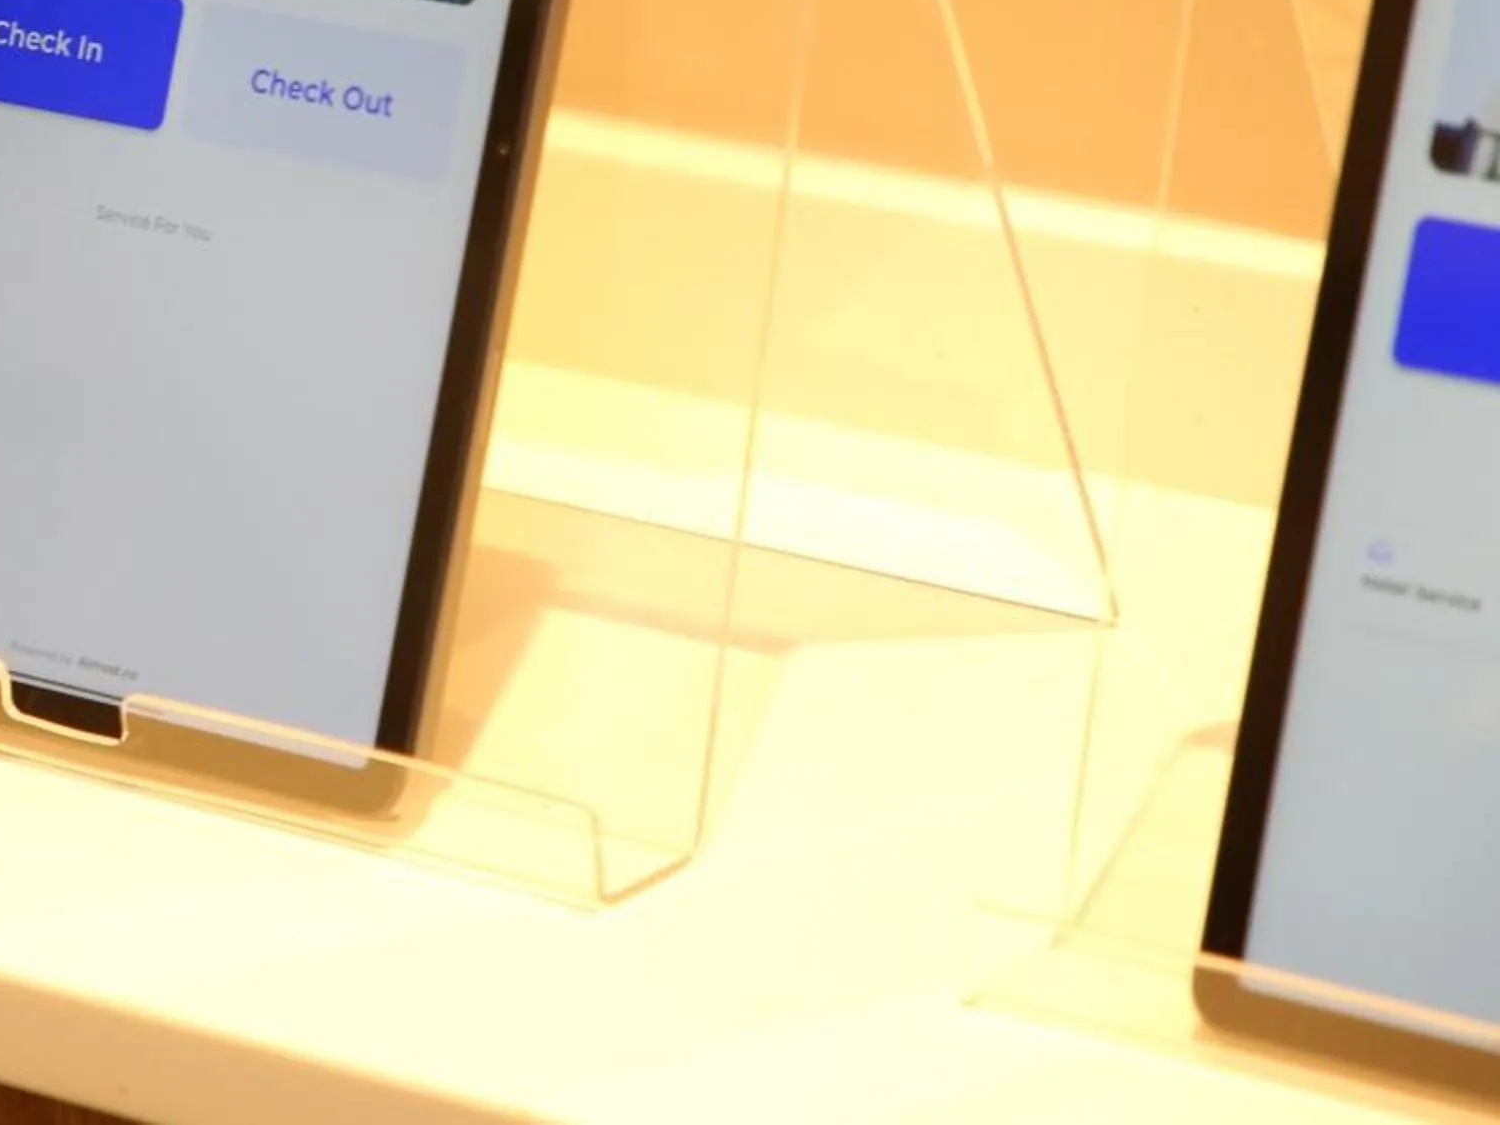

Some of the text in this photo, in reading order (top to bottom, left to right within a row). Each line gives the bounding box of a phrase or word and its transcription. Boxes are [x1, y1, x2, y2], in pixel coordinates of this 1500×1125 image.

[77, 34, 103, 63] In
[250, 68, 394, 118] Check Out
